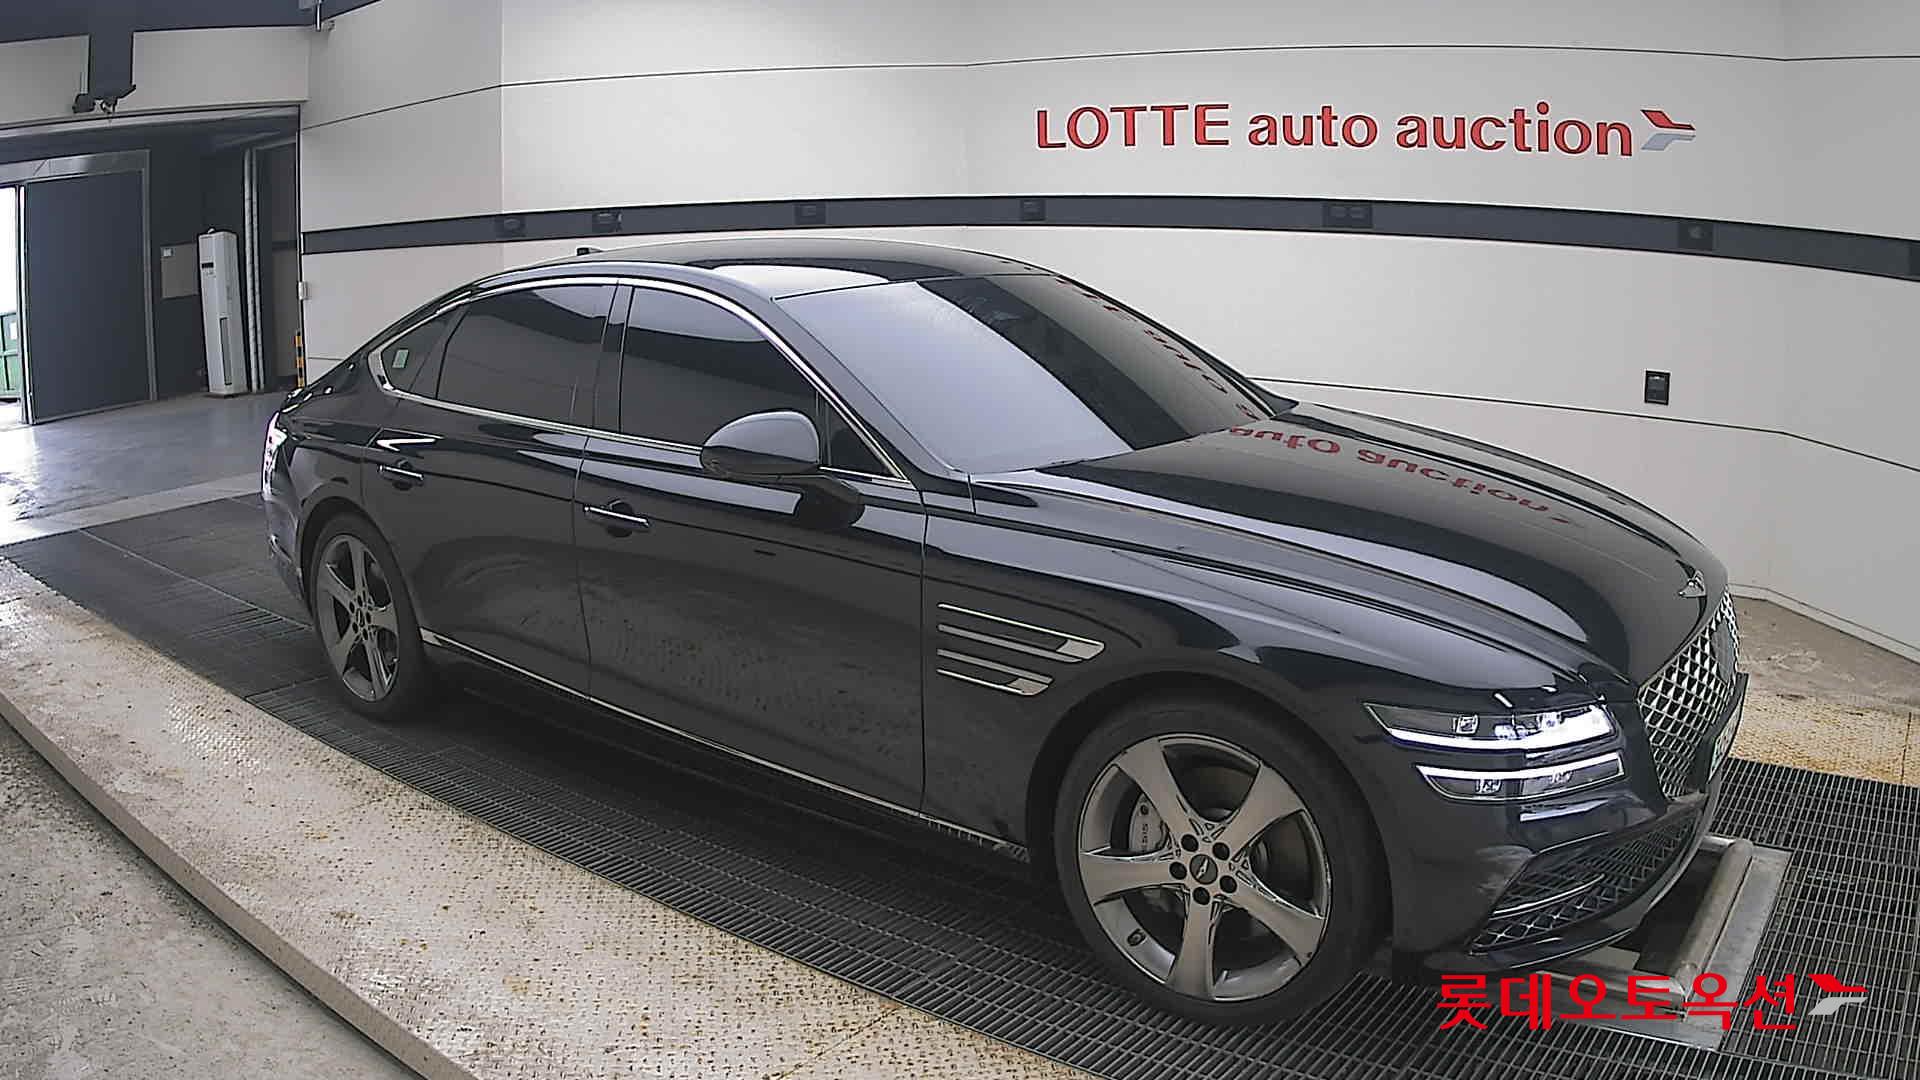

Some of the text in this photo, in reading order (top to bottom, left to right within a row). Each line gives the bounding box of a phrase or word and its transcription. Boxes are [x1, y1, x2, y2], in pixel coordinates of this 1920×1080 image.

[1037, 102, 1633, 156] LOTTE auto auction
